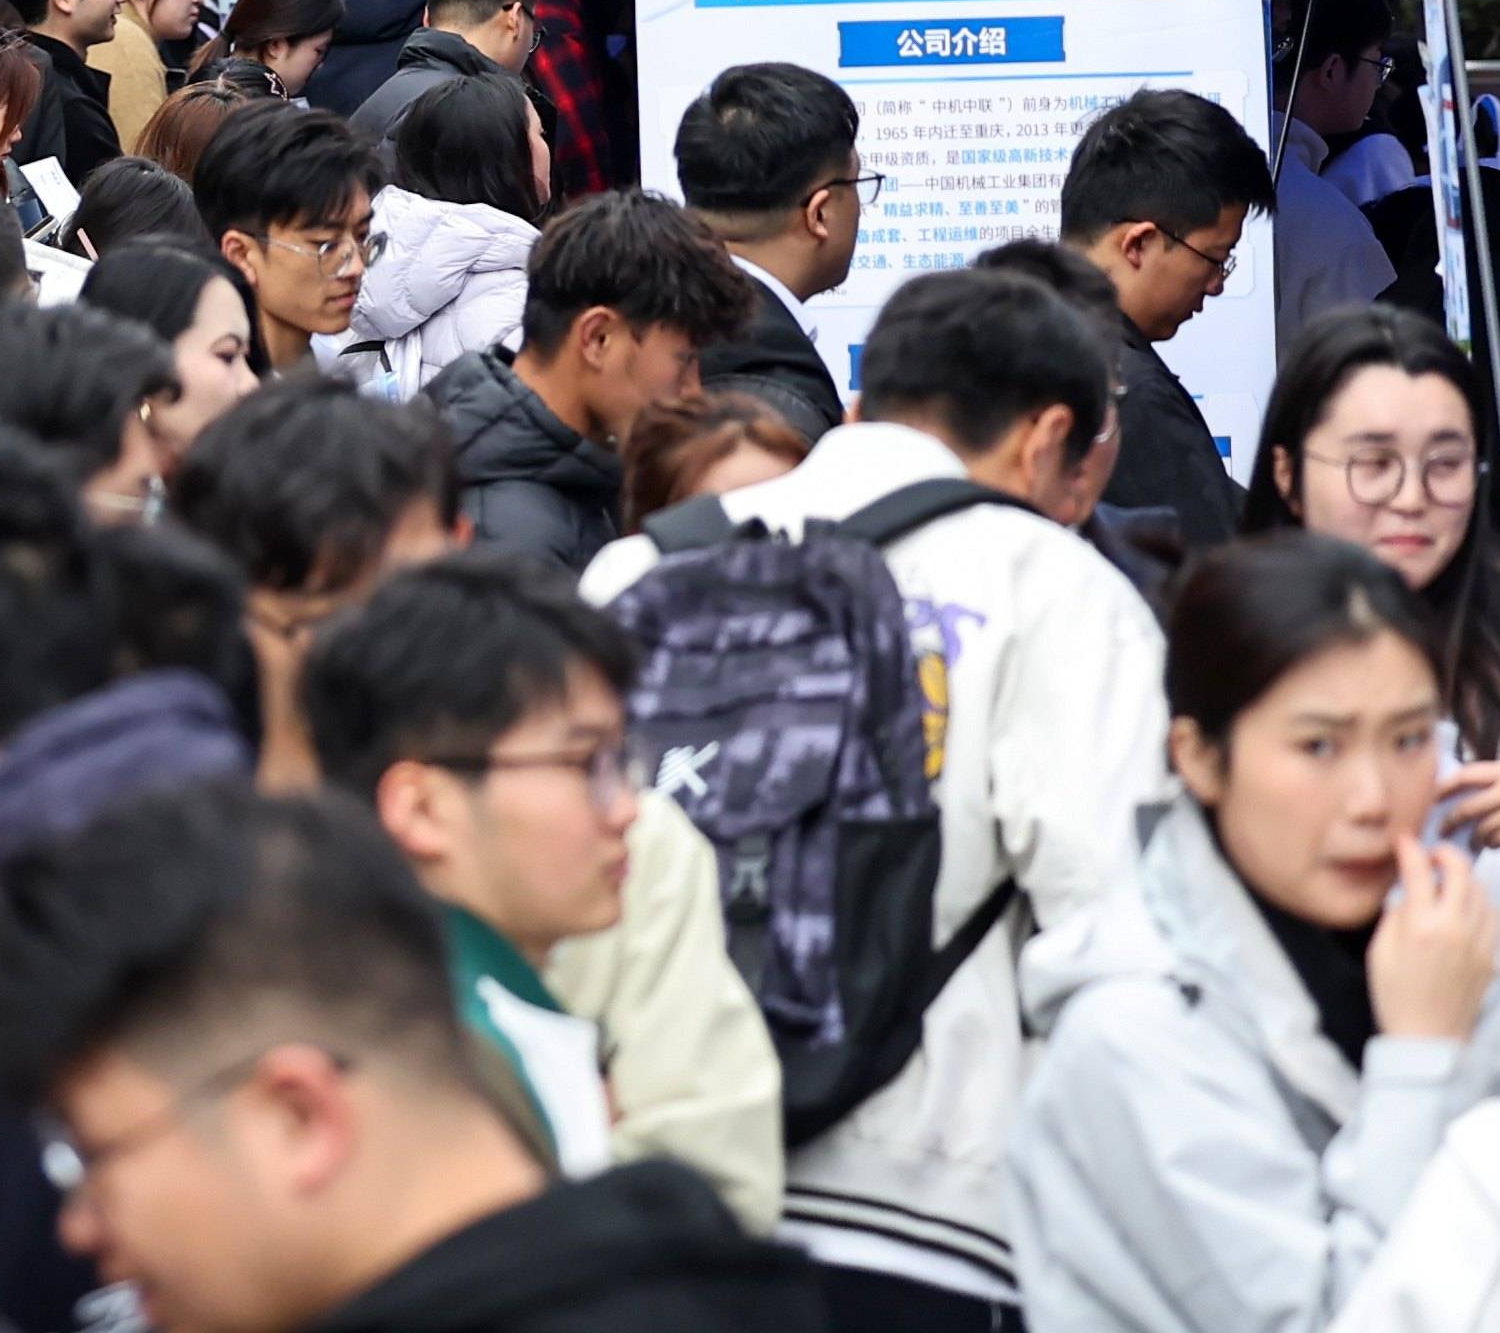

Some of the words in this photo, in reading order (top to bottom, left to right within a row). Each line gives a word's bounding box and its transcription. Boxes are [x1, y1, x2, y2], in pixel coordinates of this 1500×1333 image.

[897, 27, 1006, 58] 公司介绍
[852, 252, 966, 270] 交通、生态能源
